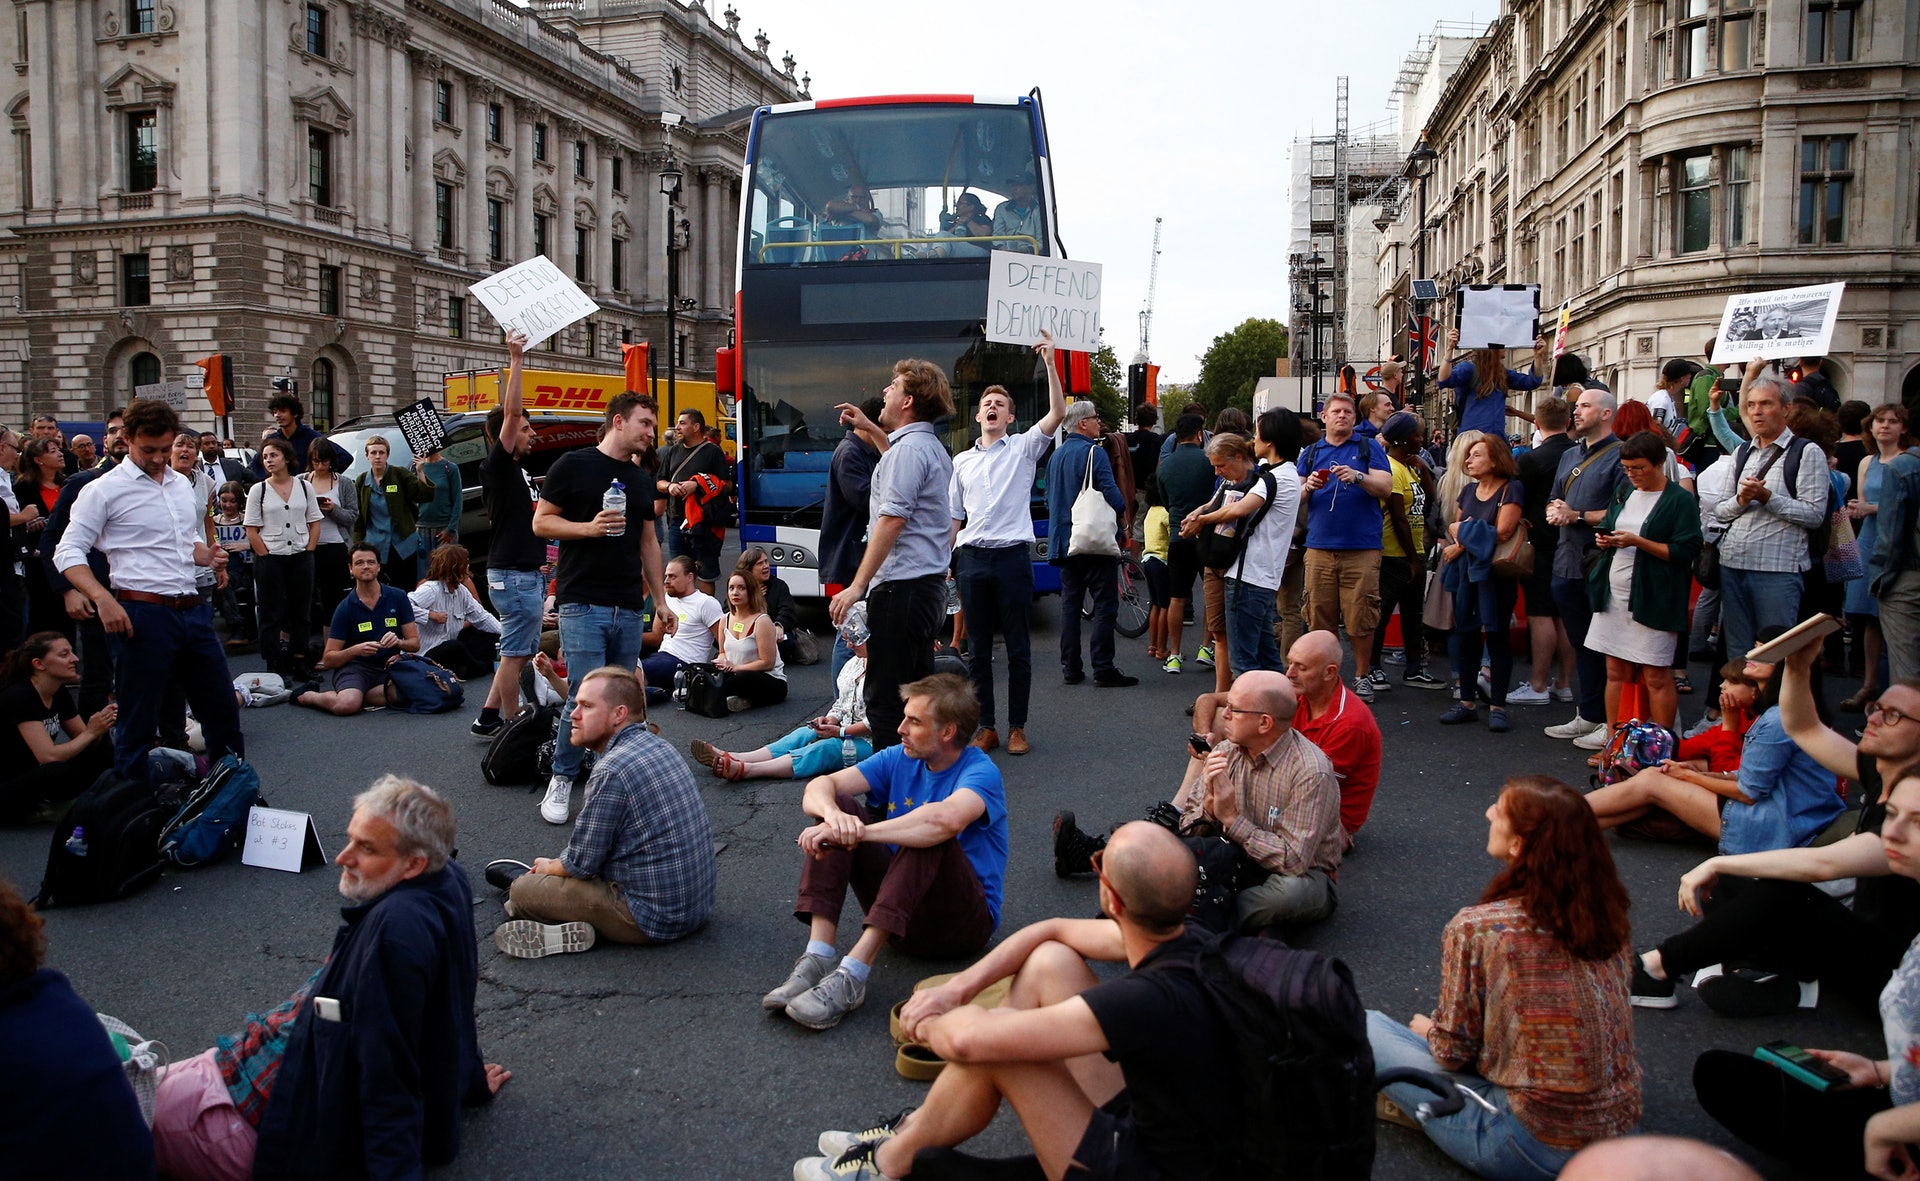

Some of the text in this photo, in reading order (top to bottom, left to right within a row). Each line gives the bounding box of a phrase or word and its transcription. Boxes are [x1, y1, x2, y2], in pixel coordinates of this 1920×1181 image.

[484, 264, 559, 306] DEFEND
[1009, 262, 1100, 300] DEFEND
[995, 300, 1098, 344] DEMOCRACY!
[1738, 341, 1764, 351] killing
[1767, 339, 1781, 348] it's
[1784, 339, 1814, 348] mother
[456, 393, 489, 406] DHL
[534, 385, 608, 409] DHL
[398, 415, 424, 456] SHUTDOWN
[404, 411, 429, 453] PARLIAMENT
[411, 411, 434, 450] RESIST THE
[416, 403, 443, 450] DEMOCRACY
[427, 409, 445, 438] DEFEND
